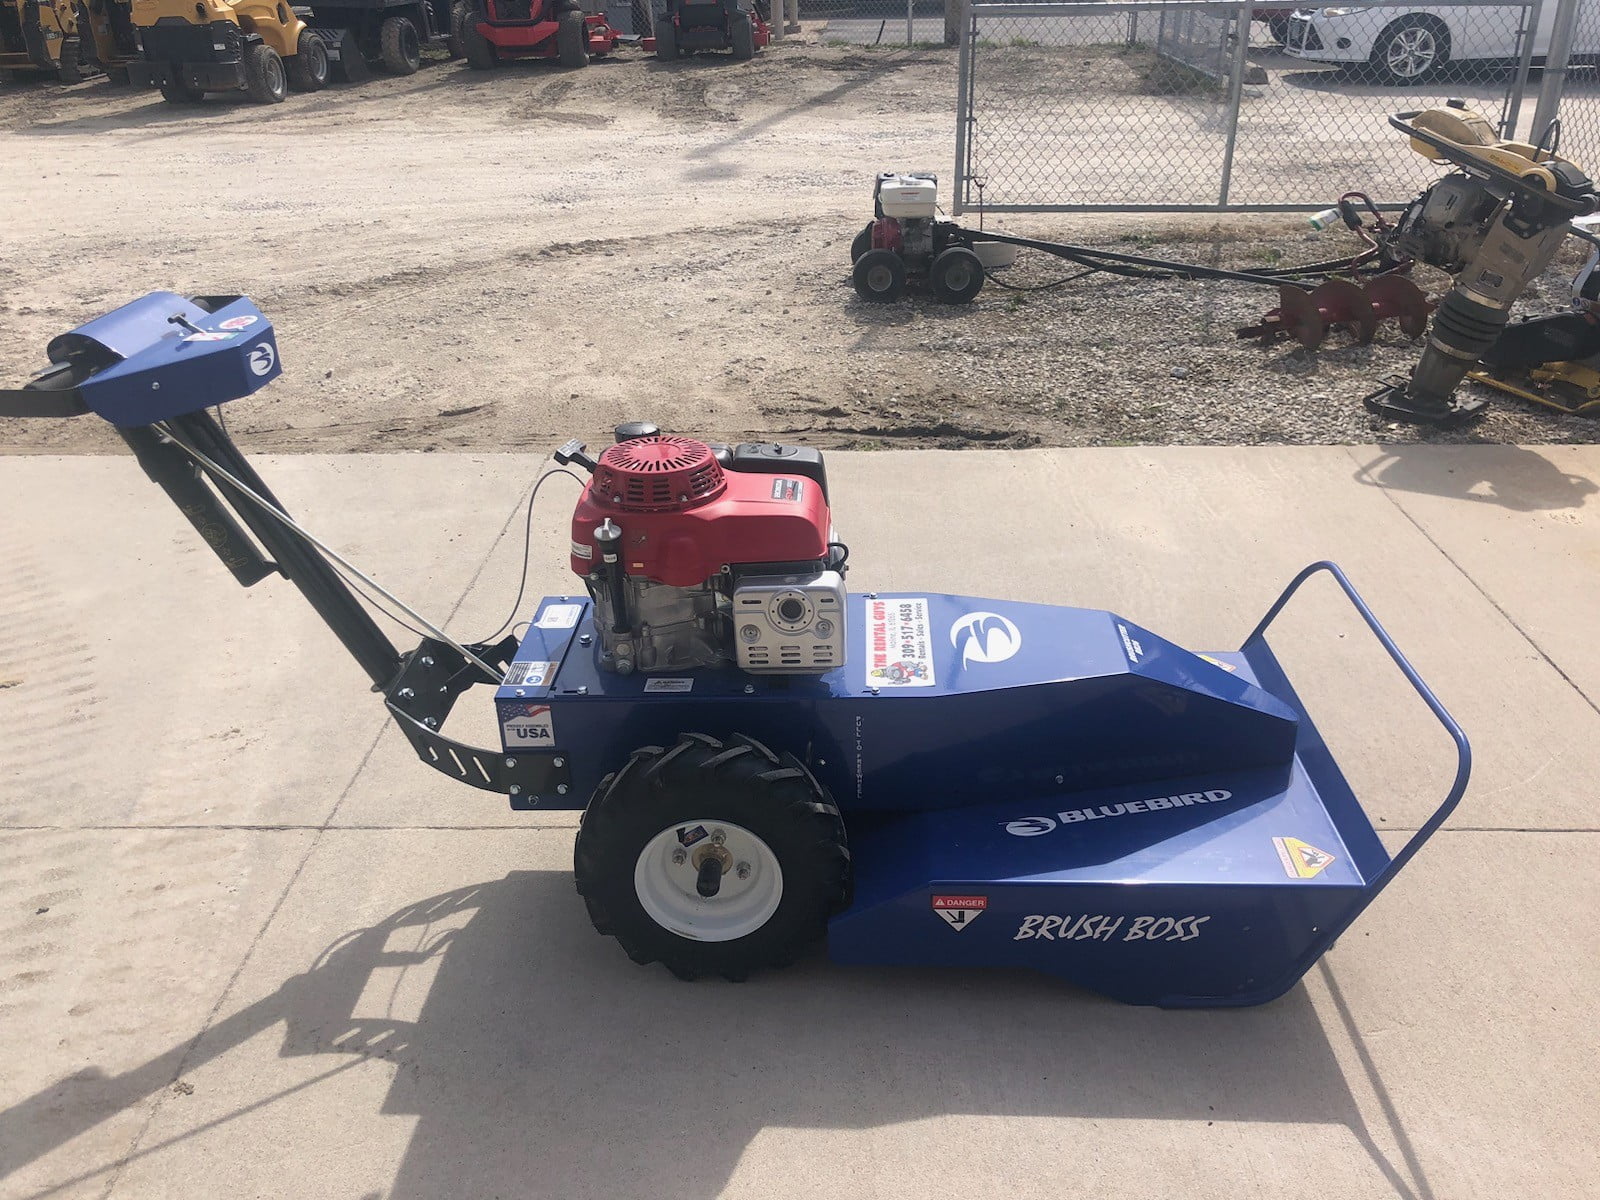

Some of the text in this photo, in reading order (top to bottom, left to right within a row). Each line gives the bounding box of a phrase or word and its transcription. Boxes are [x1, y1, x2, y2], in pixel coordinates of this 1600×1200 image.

[873, 601, 887, 668] THE RENTAL GUYS
[915, 602, 926, 659] Rentals Sales Service
[516, 728, 551, 739] USA
[856, 739, 863, 751] TO
[1057, 789, 1233, 824] BLUEBIRD
[946, 898, 985, 907] DANGER
[1013, 914, 1212, 942] BRUSH BOSS
